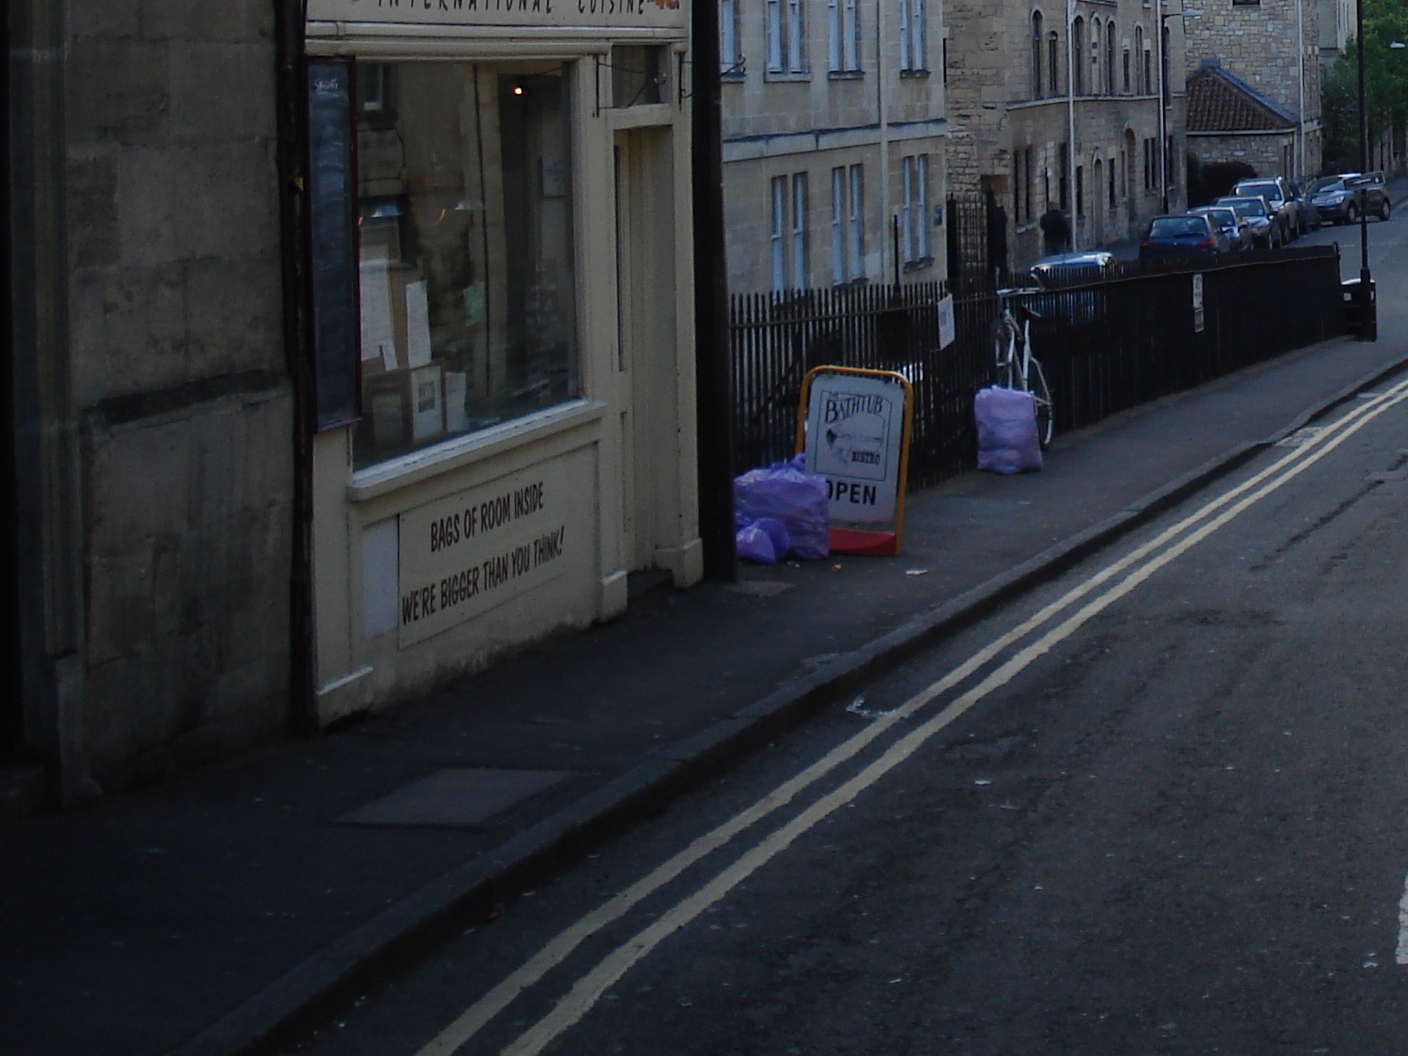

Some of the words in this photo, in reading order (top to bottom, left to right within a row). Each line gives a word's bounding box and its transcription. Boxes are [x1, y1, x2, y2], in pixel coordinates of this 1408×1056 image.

[823, 394, 883, 424] BATHTUB
[851, 451, 881, 465] BISTRO
[430, 513, 461, 553] BAGS
[463, 506, 478, 540] OF
[480, 493, 511, 534] ROOM
[513, 480, 544, 520] INSIDE
[401, 582, 437, 626] WE'RE
[440, 565, 480, 611] BIGGER
[482, 552, 509, 592] THAN
[511, 544, 531, 578] YOU
[533, 524, 566, 568] THINK!
